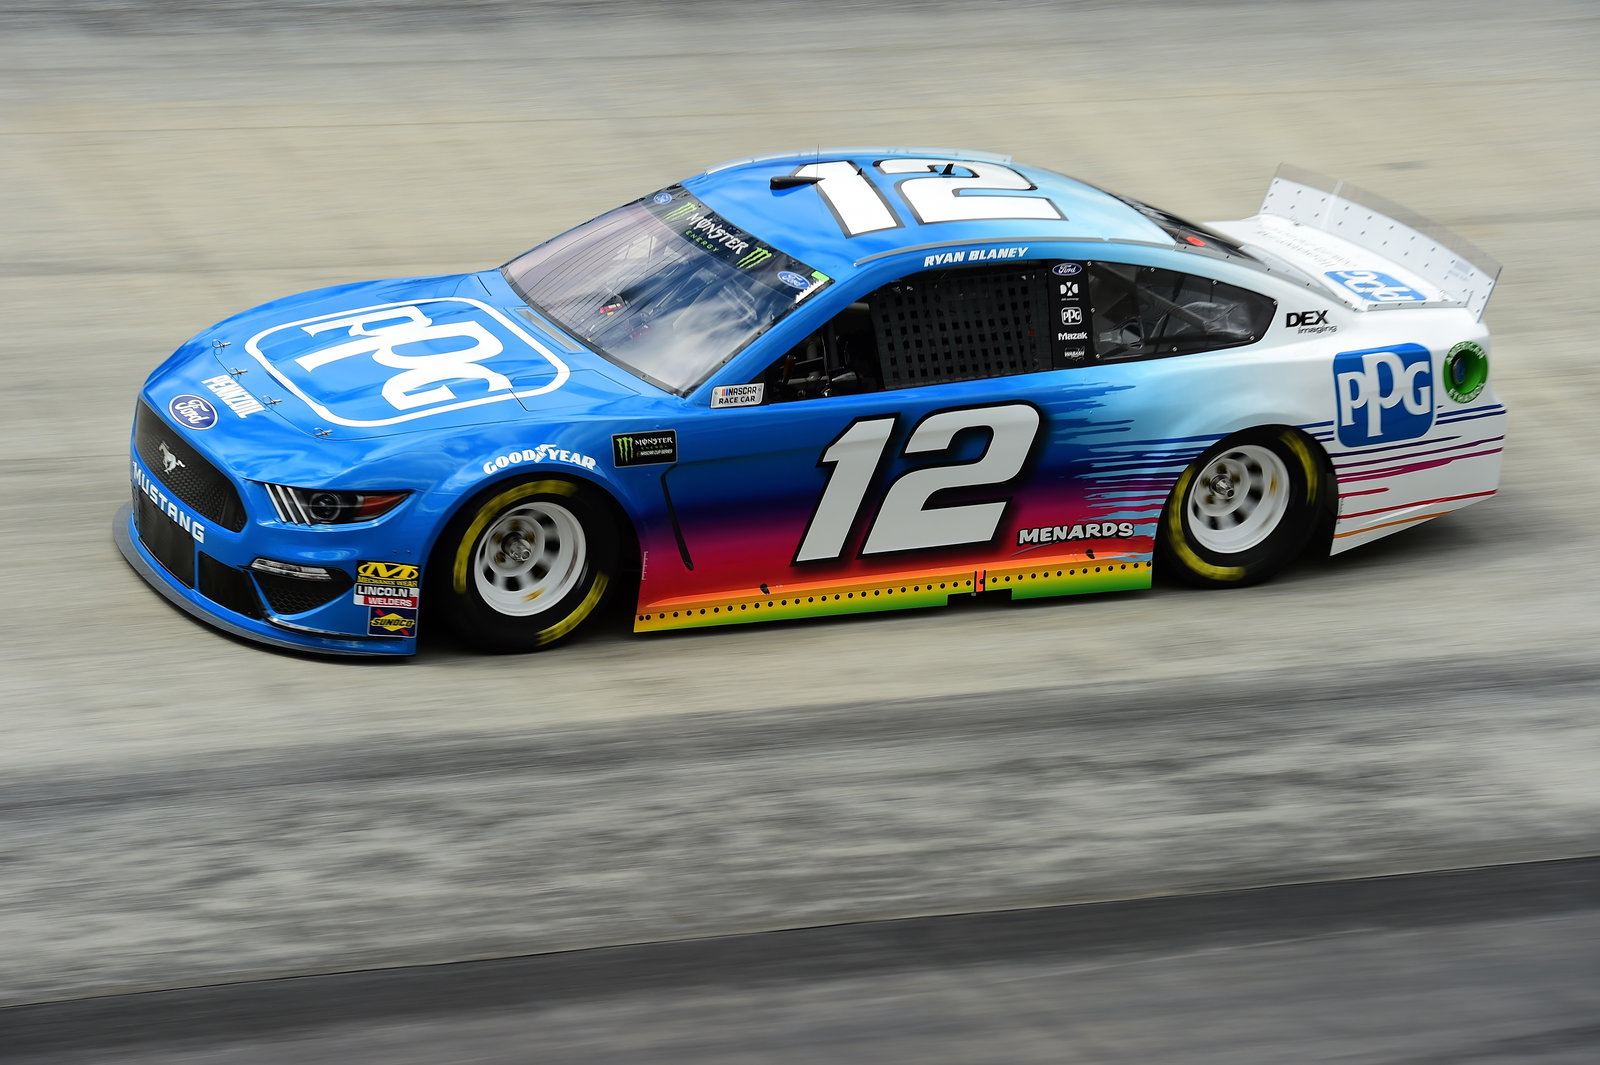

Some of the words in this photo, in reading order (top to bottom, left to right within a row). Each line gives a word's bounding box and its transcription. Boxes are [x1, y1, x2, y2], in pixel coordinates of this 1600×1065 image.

[795, 158, 1065, 237] 12
[685, 230, 719, 252] ENERGY
[686, 212, 749, 255] MONSTER
[924, 250, 966, 268] RYAN
[967, 246, 1030, 261] BLANEY
[780, 273, 806, 288] Ford
[1062, 309, 1081, 323] PPG
[1286, 309, 1329, 328] DEX
[1057, 331, 1088, 341] Mazak
[1297, 324, 1338, 334] imaging
[718, 396, 739, 405] RACE
[740, 395, 756, 403] CAR
[728, 386, 757, 397] NASCAR
[1338, 352, 1431, 438] PPG
[174, 398, 212, 425] Ford
[634, 436, 674, 447] MONSTER
[482, 444, 597, 475] GOODYEAR
[793, 401, 1042, 564] 12
[132, 461, 206, 544] MUSTANG
[1018, 521, 1136, 545] MENARDS
[357, 585, 408, 598] LINCOLN
[368, 597, 413, 607] WELDERS
[372, 618, 414, 628] SUNOCO
